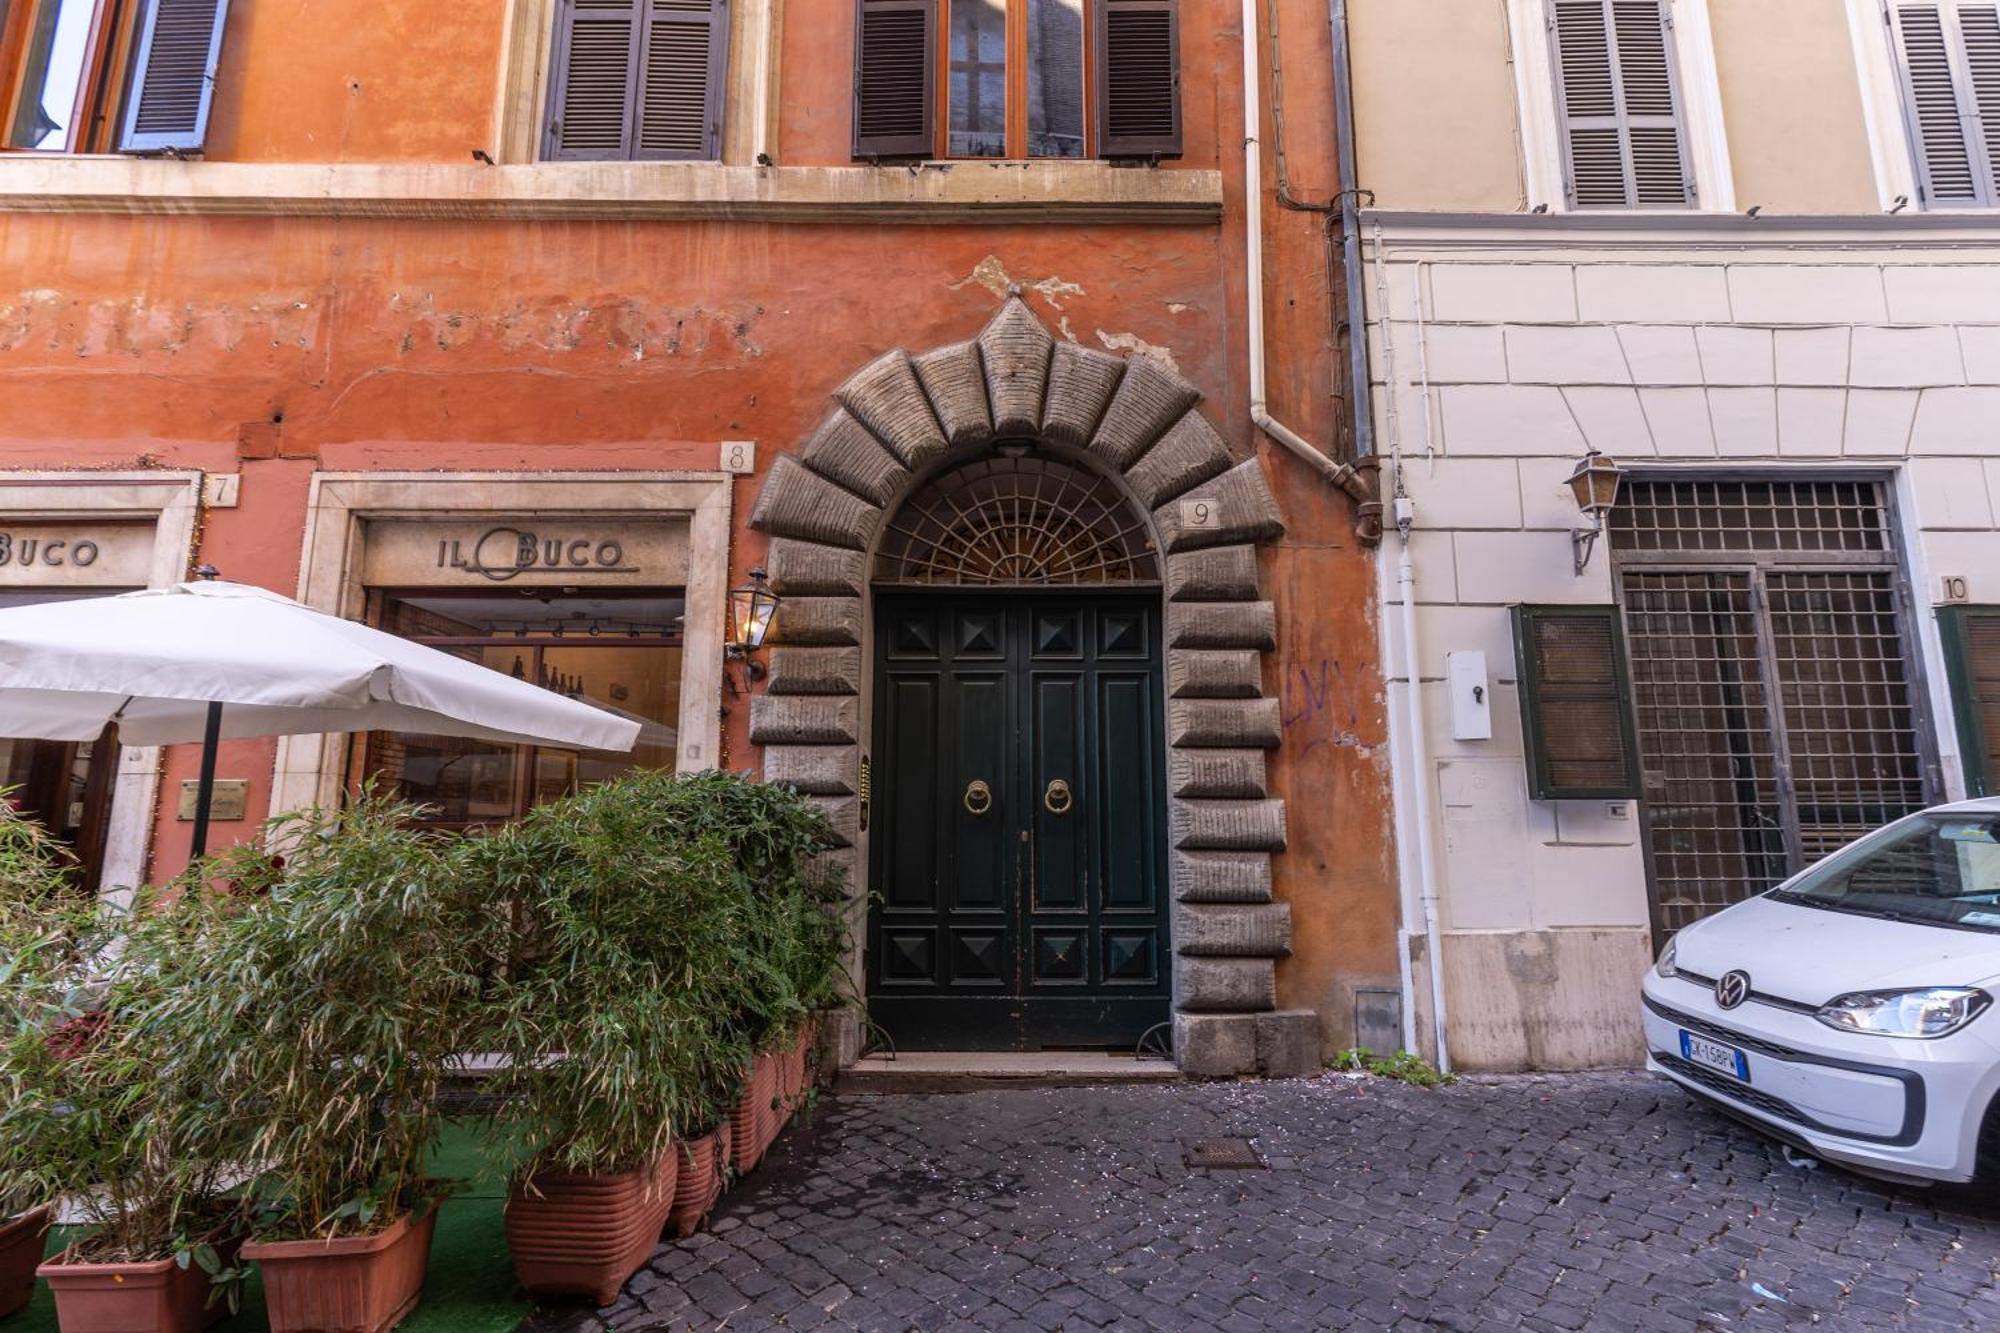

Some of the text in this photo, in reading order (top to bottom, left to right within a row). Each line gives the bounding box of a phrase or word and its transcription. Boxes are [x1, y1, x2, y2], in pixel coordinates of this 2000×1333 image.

[730, 445, 744, 469] 8
[214, 477, 228, 502] 7
[1191, 503, 1209, 525] 9
[437, 532, 623, 568] IL BUCO
[1946, 578, 1967, 599] 10
